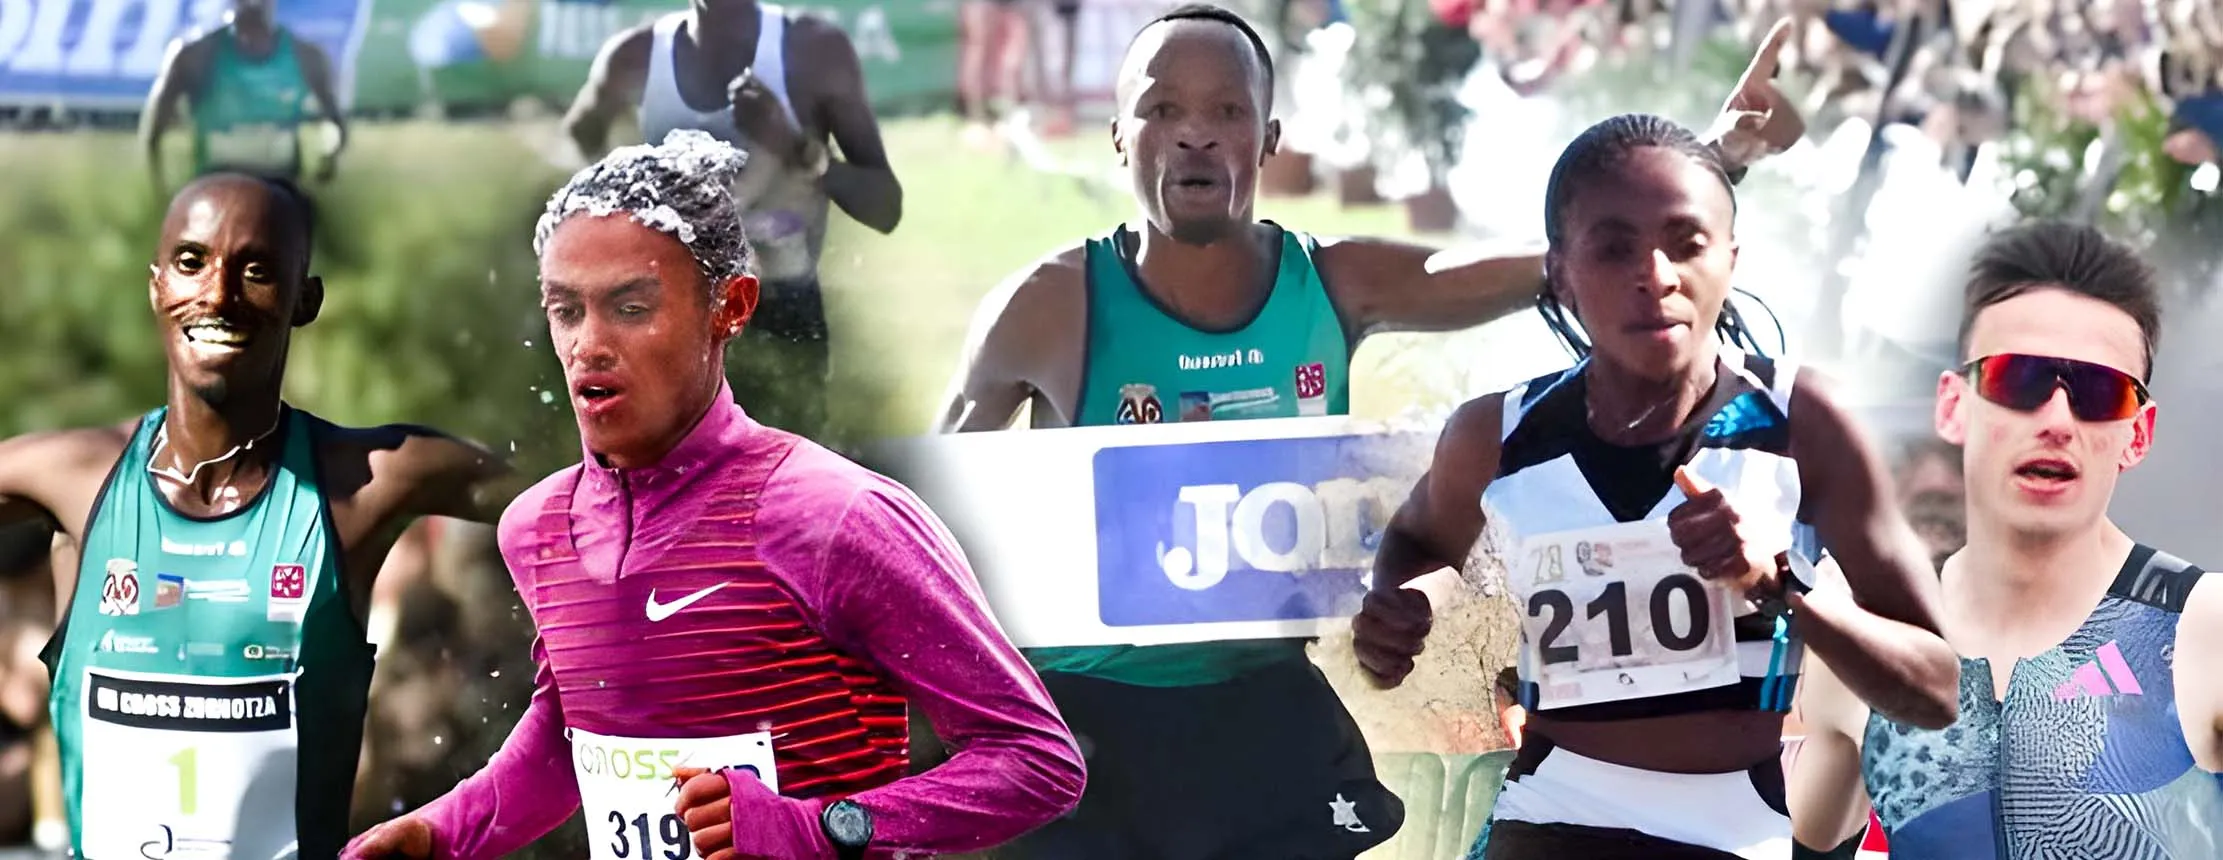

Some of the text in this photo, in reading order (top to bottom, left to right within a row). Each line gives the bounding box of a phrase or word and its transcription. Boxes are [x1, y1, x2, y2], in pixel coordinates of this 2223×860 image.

[1528, 573, 1710, 665] 210
[167, 747, 197, 816] 1
[608, 810, 691, 860] 319
